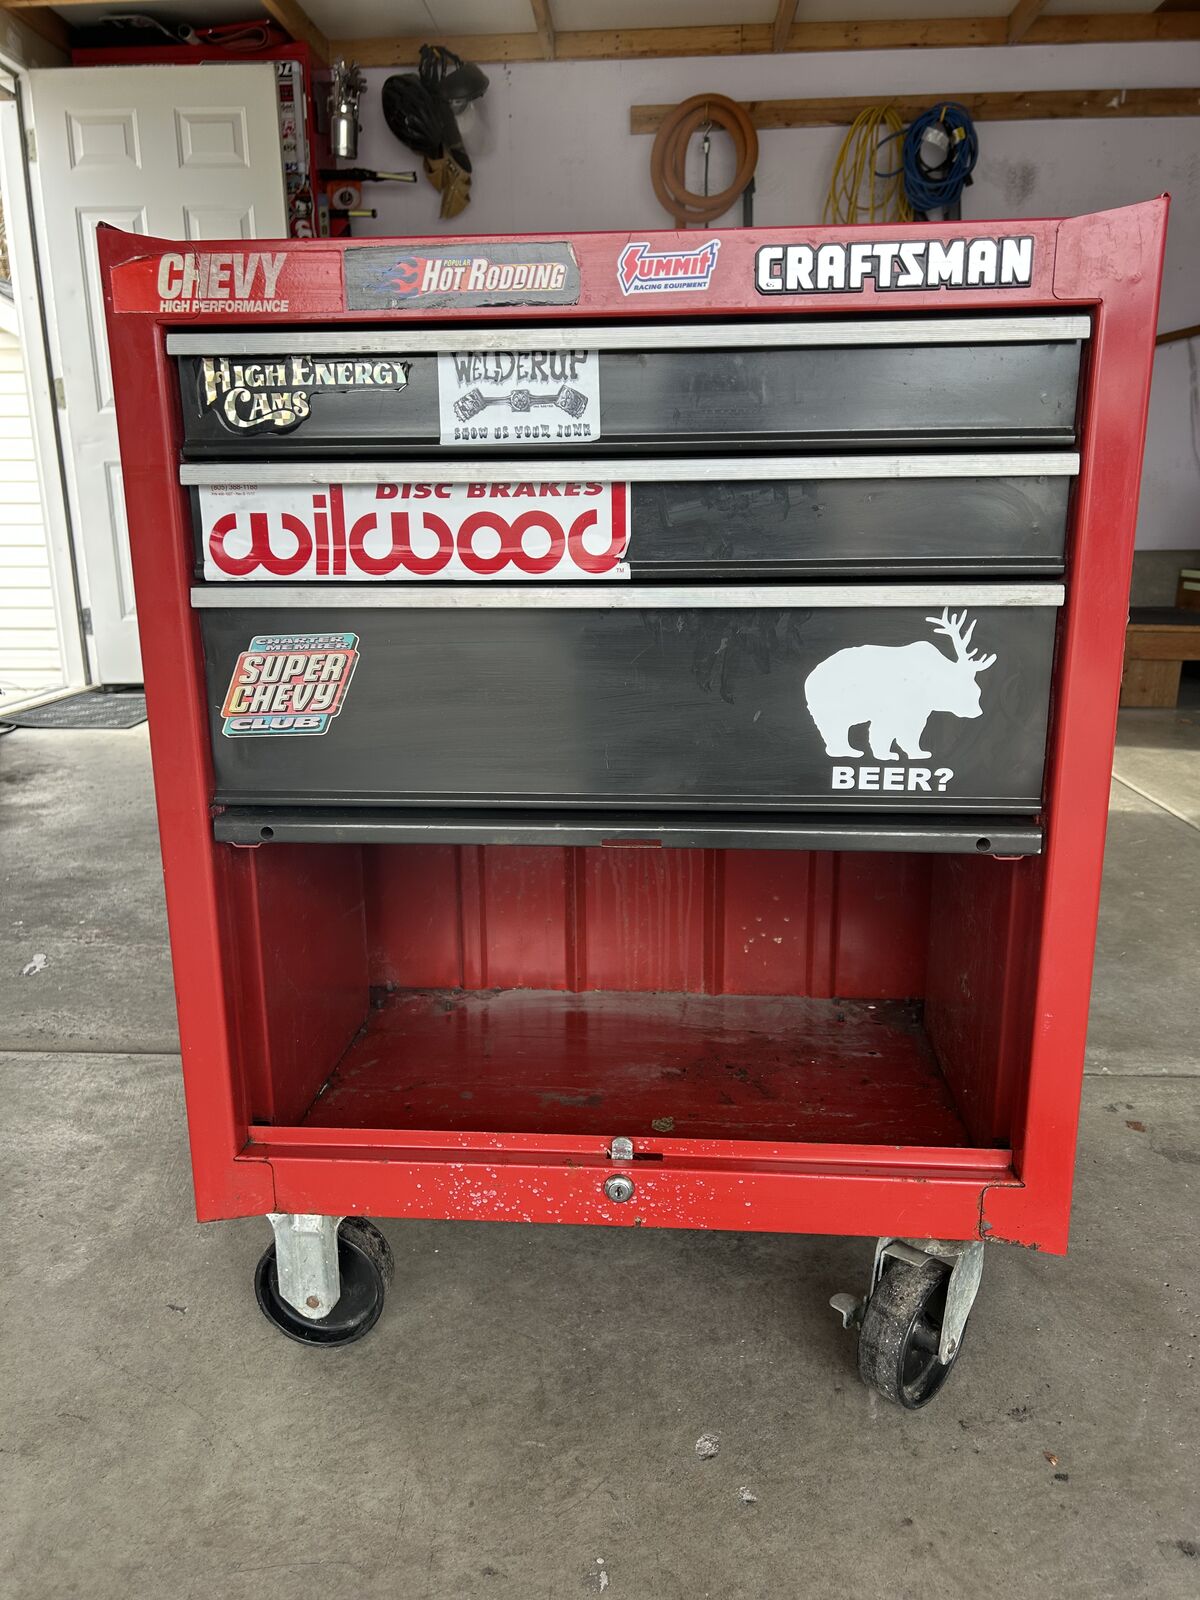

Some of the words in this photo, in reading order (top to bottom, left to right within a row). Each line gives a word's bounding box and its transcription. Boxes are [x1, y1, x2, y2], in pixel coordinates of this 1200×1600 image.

[157, 252, 288, 300] CHEVY
[421, 259, 465, 292] HOT
[467, 258, 566, 291] RODDING
[443, 259, 471, 267] POPULAR
[623, 248, 711, 284] SUMMIT
[757, 237, 1034, 293] CRAFTSMAN
[664, 281, 707, 289] EQUIPMENT
[160, 300, 190, 312] HIGH
[192, 300, 289, 312] PERFORMANCE
[202, 357, 286, 406] HIGH
[291, 355, 408, 386] ENERGY
[451, 350, 589, 387] WELDERUP
[224, 387, 310, 428] CAMS
[454, 426, 489, 441] SHOW
[494, 425, 509, 439] US
[514, 423, 551, 439] YOUR
[556, 422, 592, 439] JUNK
[375, 483, 453, 500] DISC
[466, 482, 604, 499] BRAKES
[209, 482, 627, 576] wilwood
[255, 637, 345, 645] CHARTER
[265, 643, 350, 651] MEMBER
[238, 653, 348, 684] SUPER
[228, 683, 340, 713] CHEVY
[229, 717, 322, 731] CLUB
[831, 766, 954, 792] BEER?
